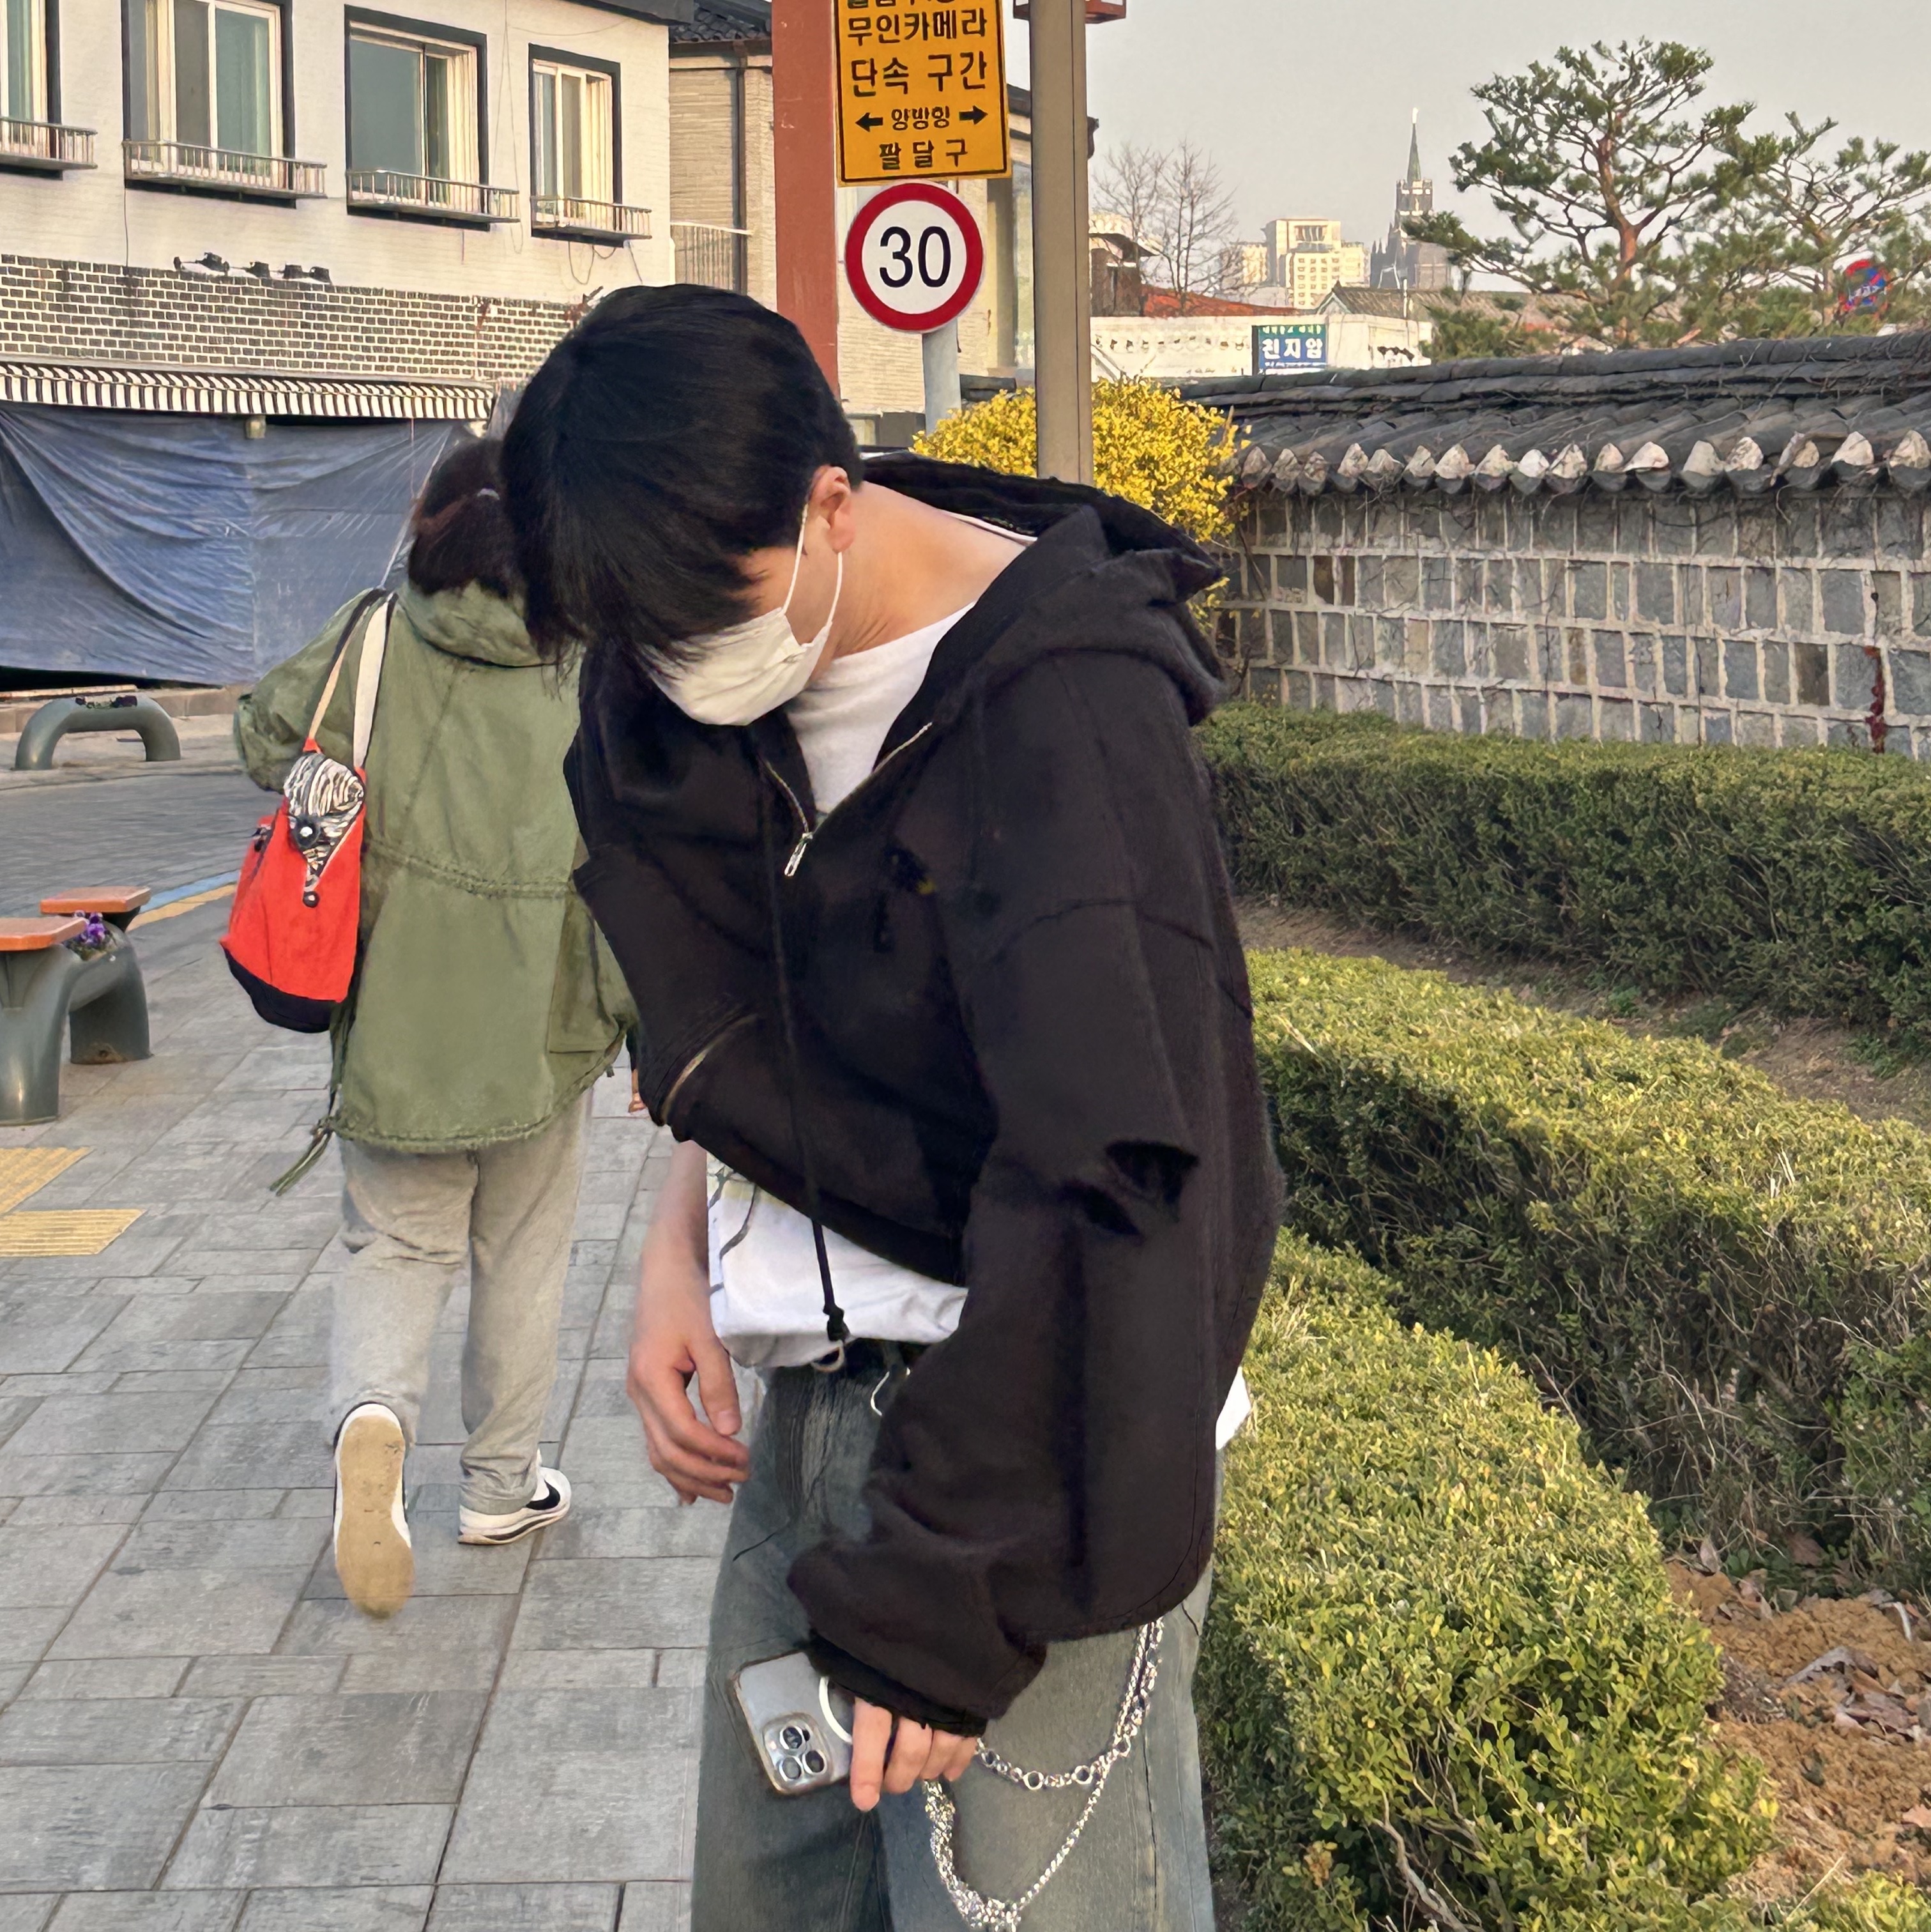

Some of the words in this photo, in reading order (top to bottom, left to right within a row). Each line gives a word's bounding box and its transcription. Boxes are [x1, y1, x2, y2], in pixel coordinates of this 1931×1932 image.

[848, 8, 988, 46] 무인카메라
[851, 57, 909, 97] 단속
[927, 50, 988, 91] 구간
[891, 105, 950, 131] 양방향
[880, 226, 951, 288] 30
